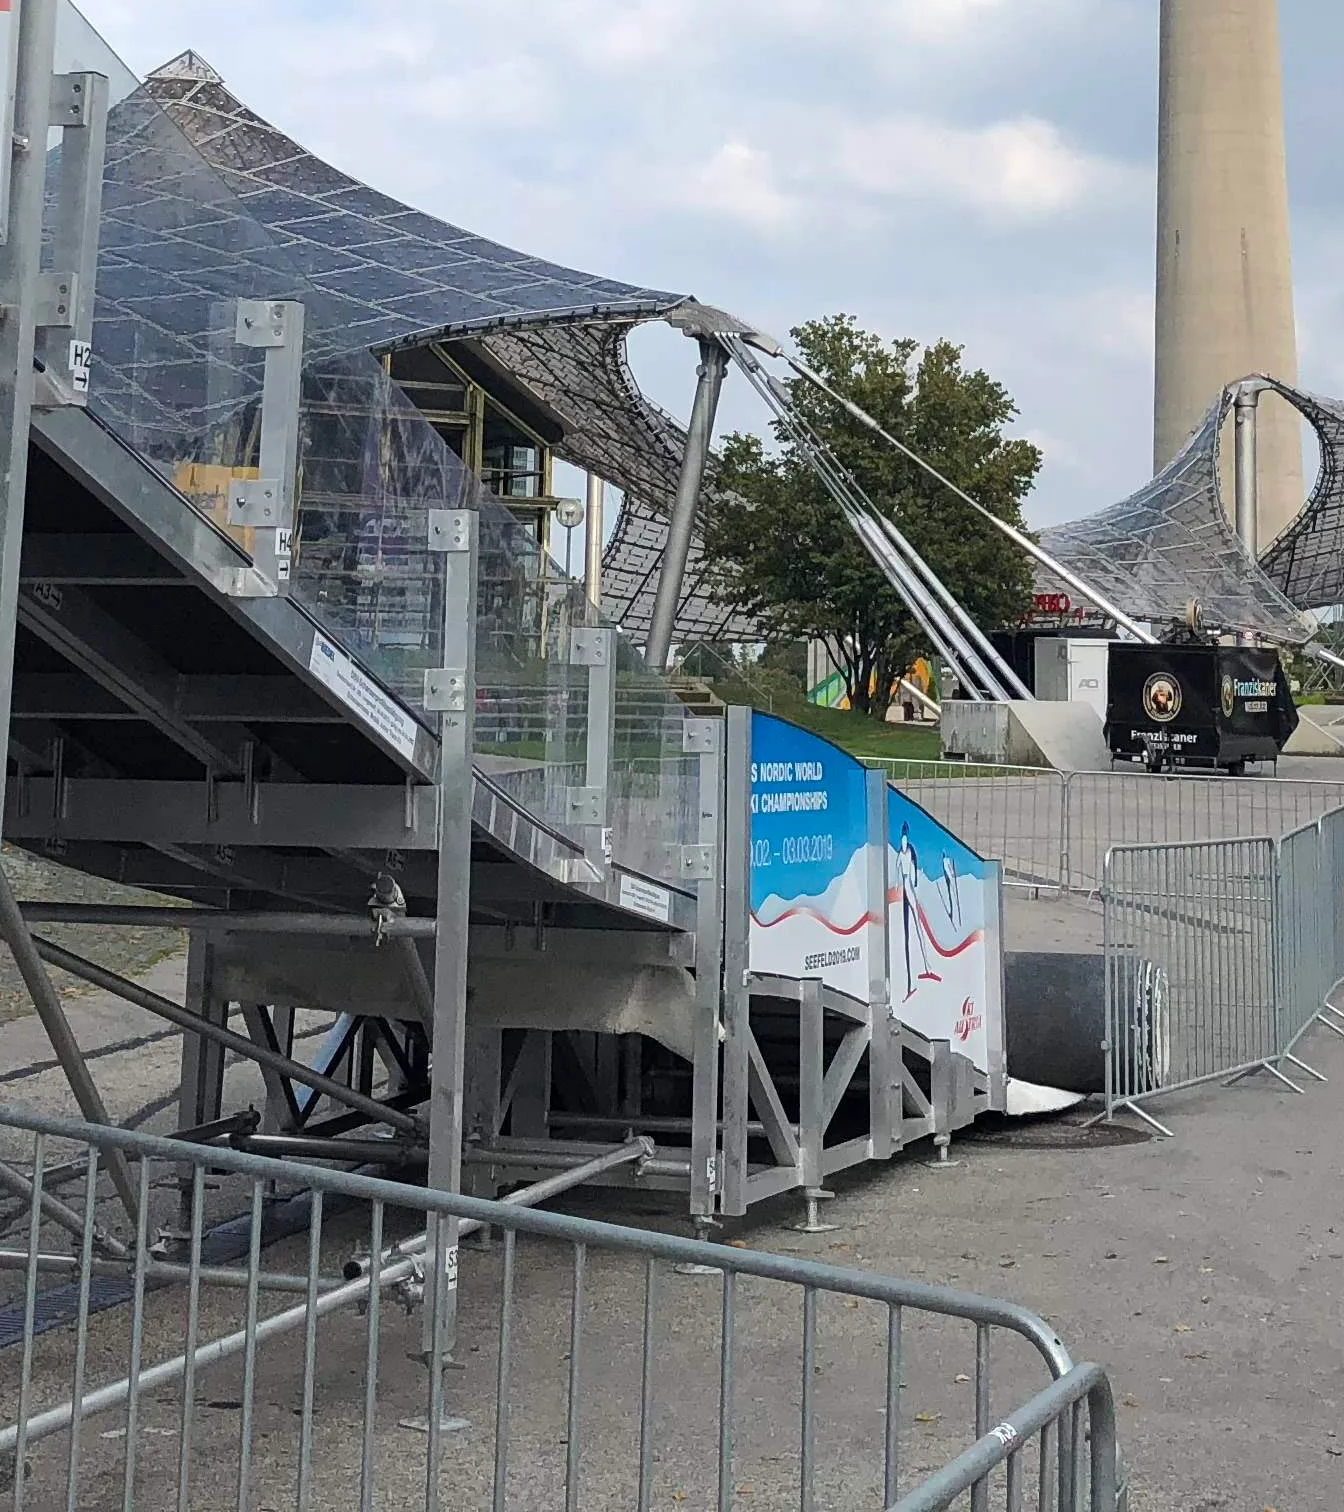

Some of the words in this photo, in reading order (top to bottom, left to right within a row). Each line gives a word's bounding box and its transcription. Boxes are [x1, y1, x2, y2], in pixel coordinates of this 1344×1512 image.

[74, 345, 91, 367] H2
[279, 532, 292, 552] H4
[1233, 677, 1277, 696] Franziskaner
[760, 763, 793, 781] NORDIC
[795, 762, 823, 781] WORLD
[751, 793, 759, 813] KI
[761, 791, 828, 813] CHAMPIONSHIPS
[782, 834, 833, 864] 03.03.2019
